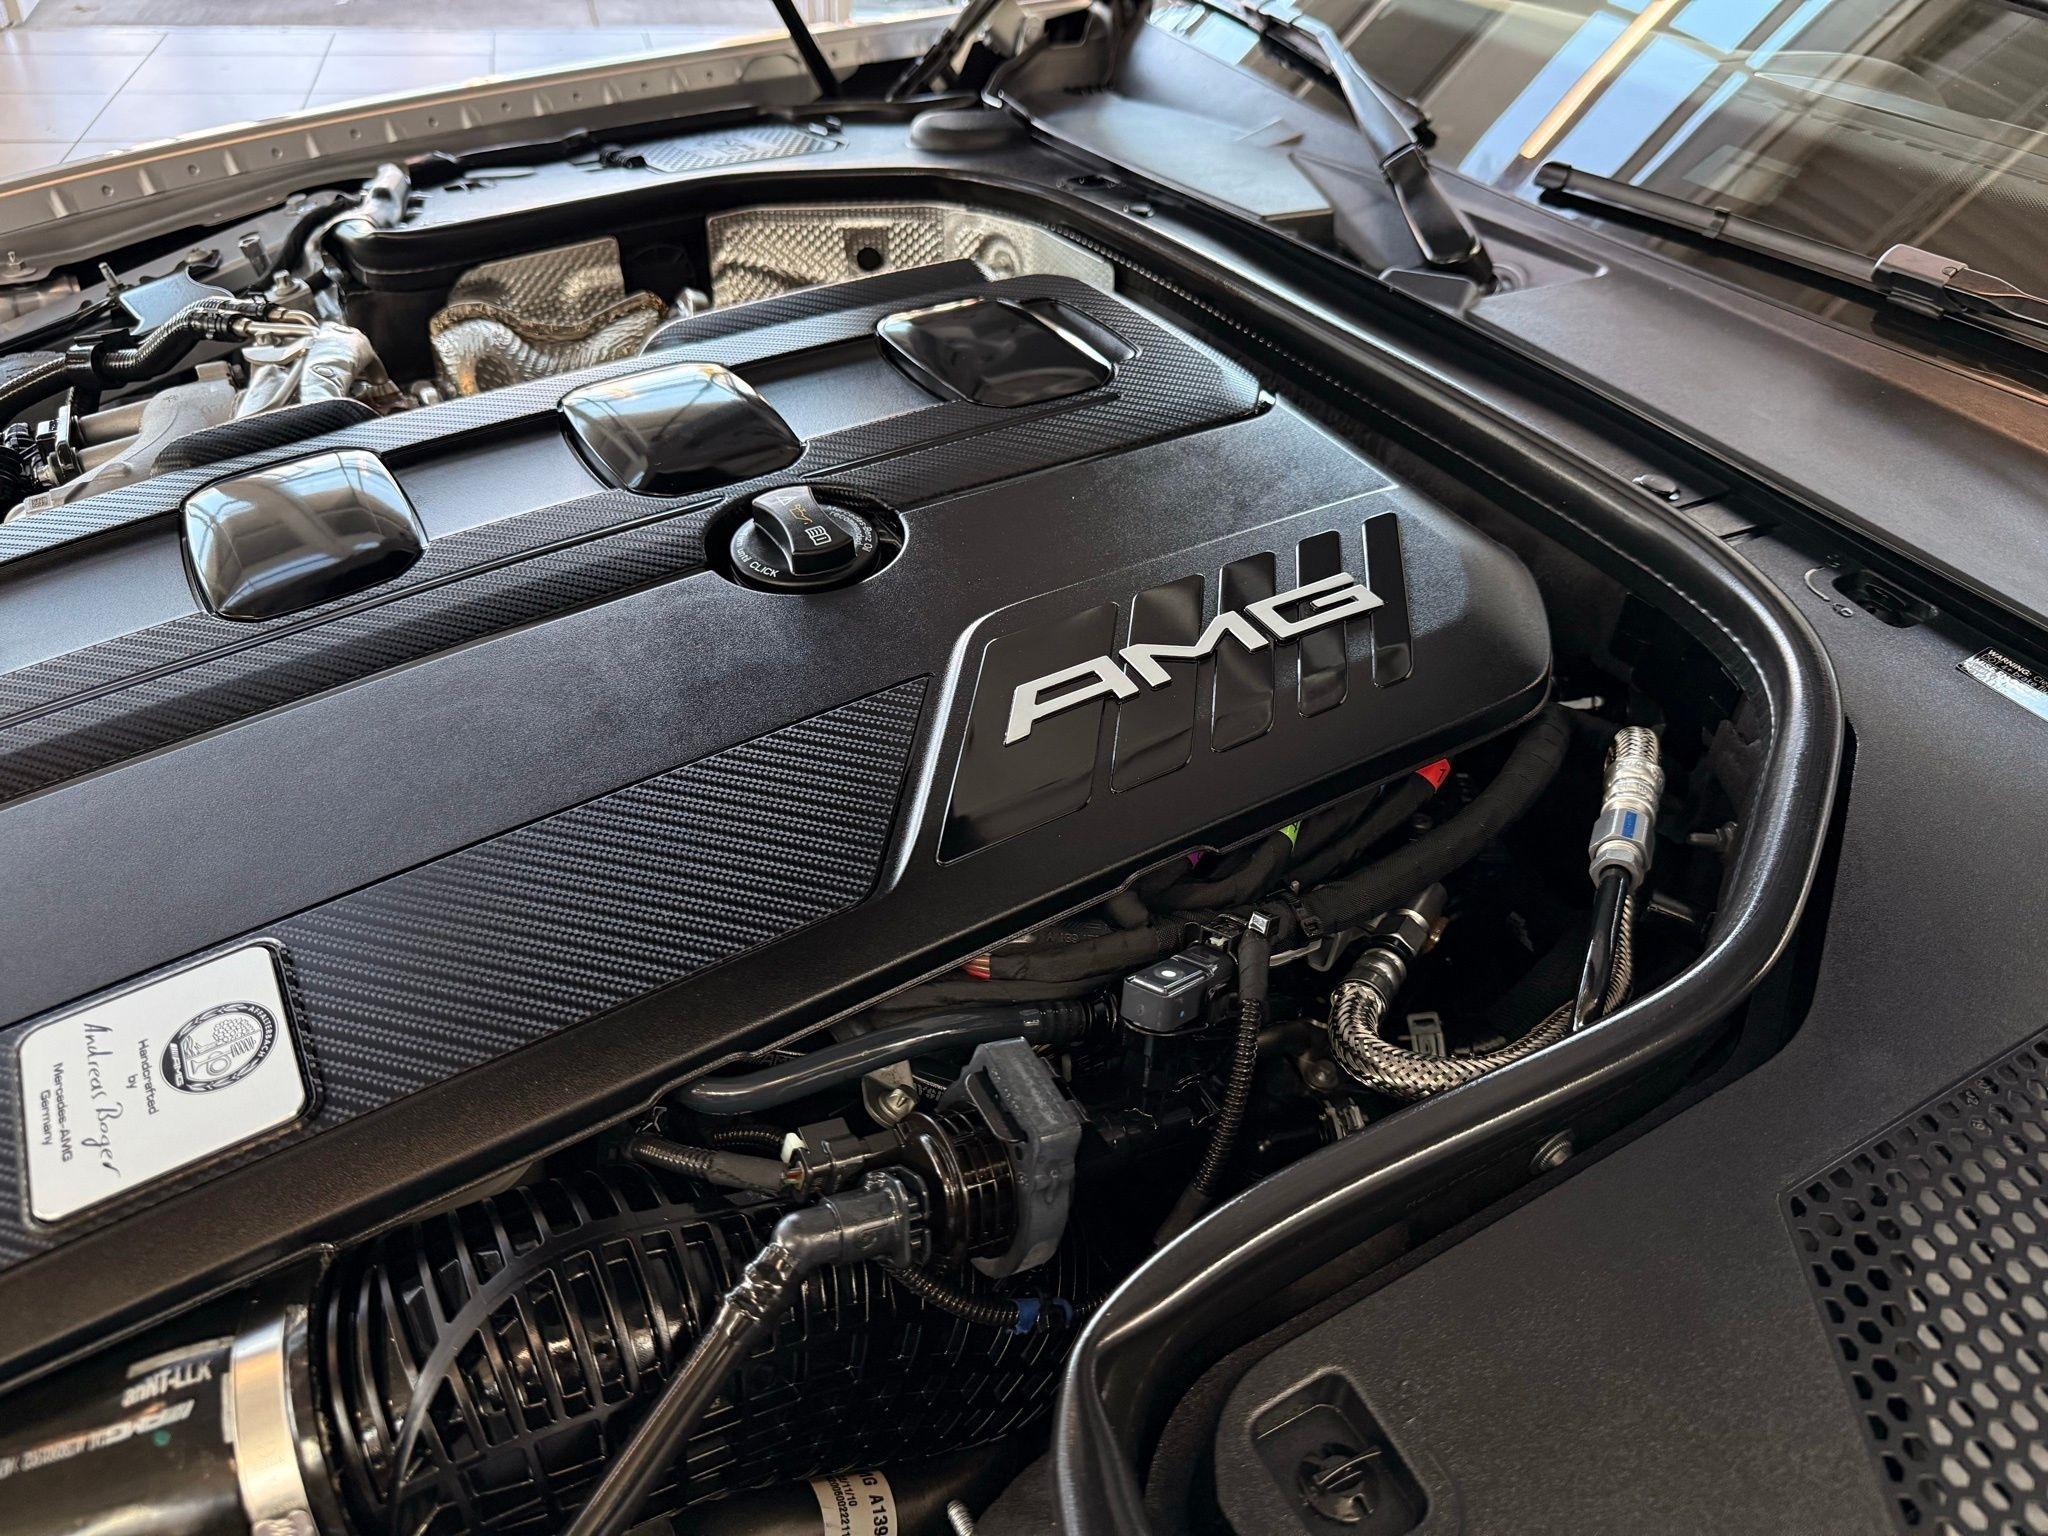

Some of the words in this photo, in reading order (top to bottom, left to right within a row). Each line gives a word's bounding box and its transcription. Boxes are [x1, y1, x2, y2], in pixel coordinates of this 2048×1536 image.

[750, 561, 779, 578] CLICK
[1003, 571, 1386, 747] AMG
[1981, 653, 2001, 666] DOT
[2012, 672, 2037, 687] brake
[1988, 649, 2032, 677] WARNING:
[248, 1005, 274, 1058] AFFALTERBACH
[83, 1023, 113, 1100] Andreas
[126, 1074, 139, 1089] by
[138, 1038, 160, 1115] Handcrafted
[40, 1089, 53, 1146] Germany
[53, 1062, 74, 1163] Mercedes-AMG
